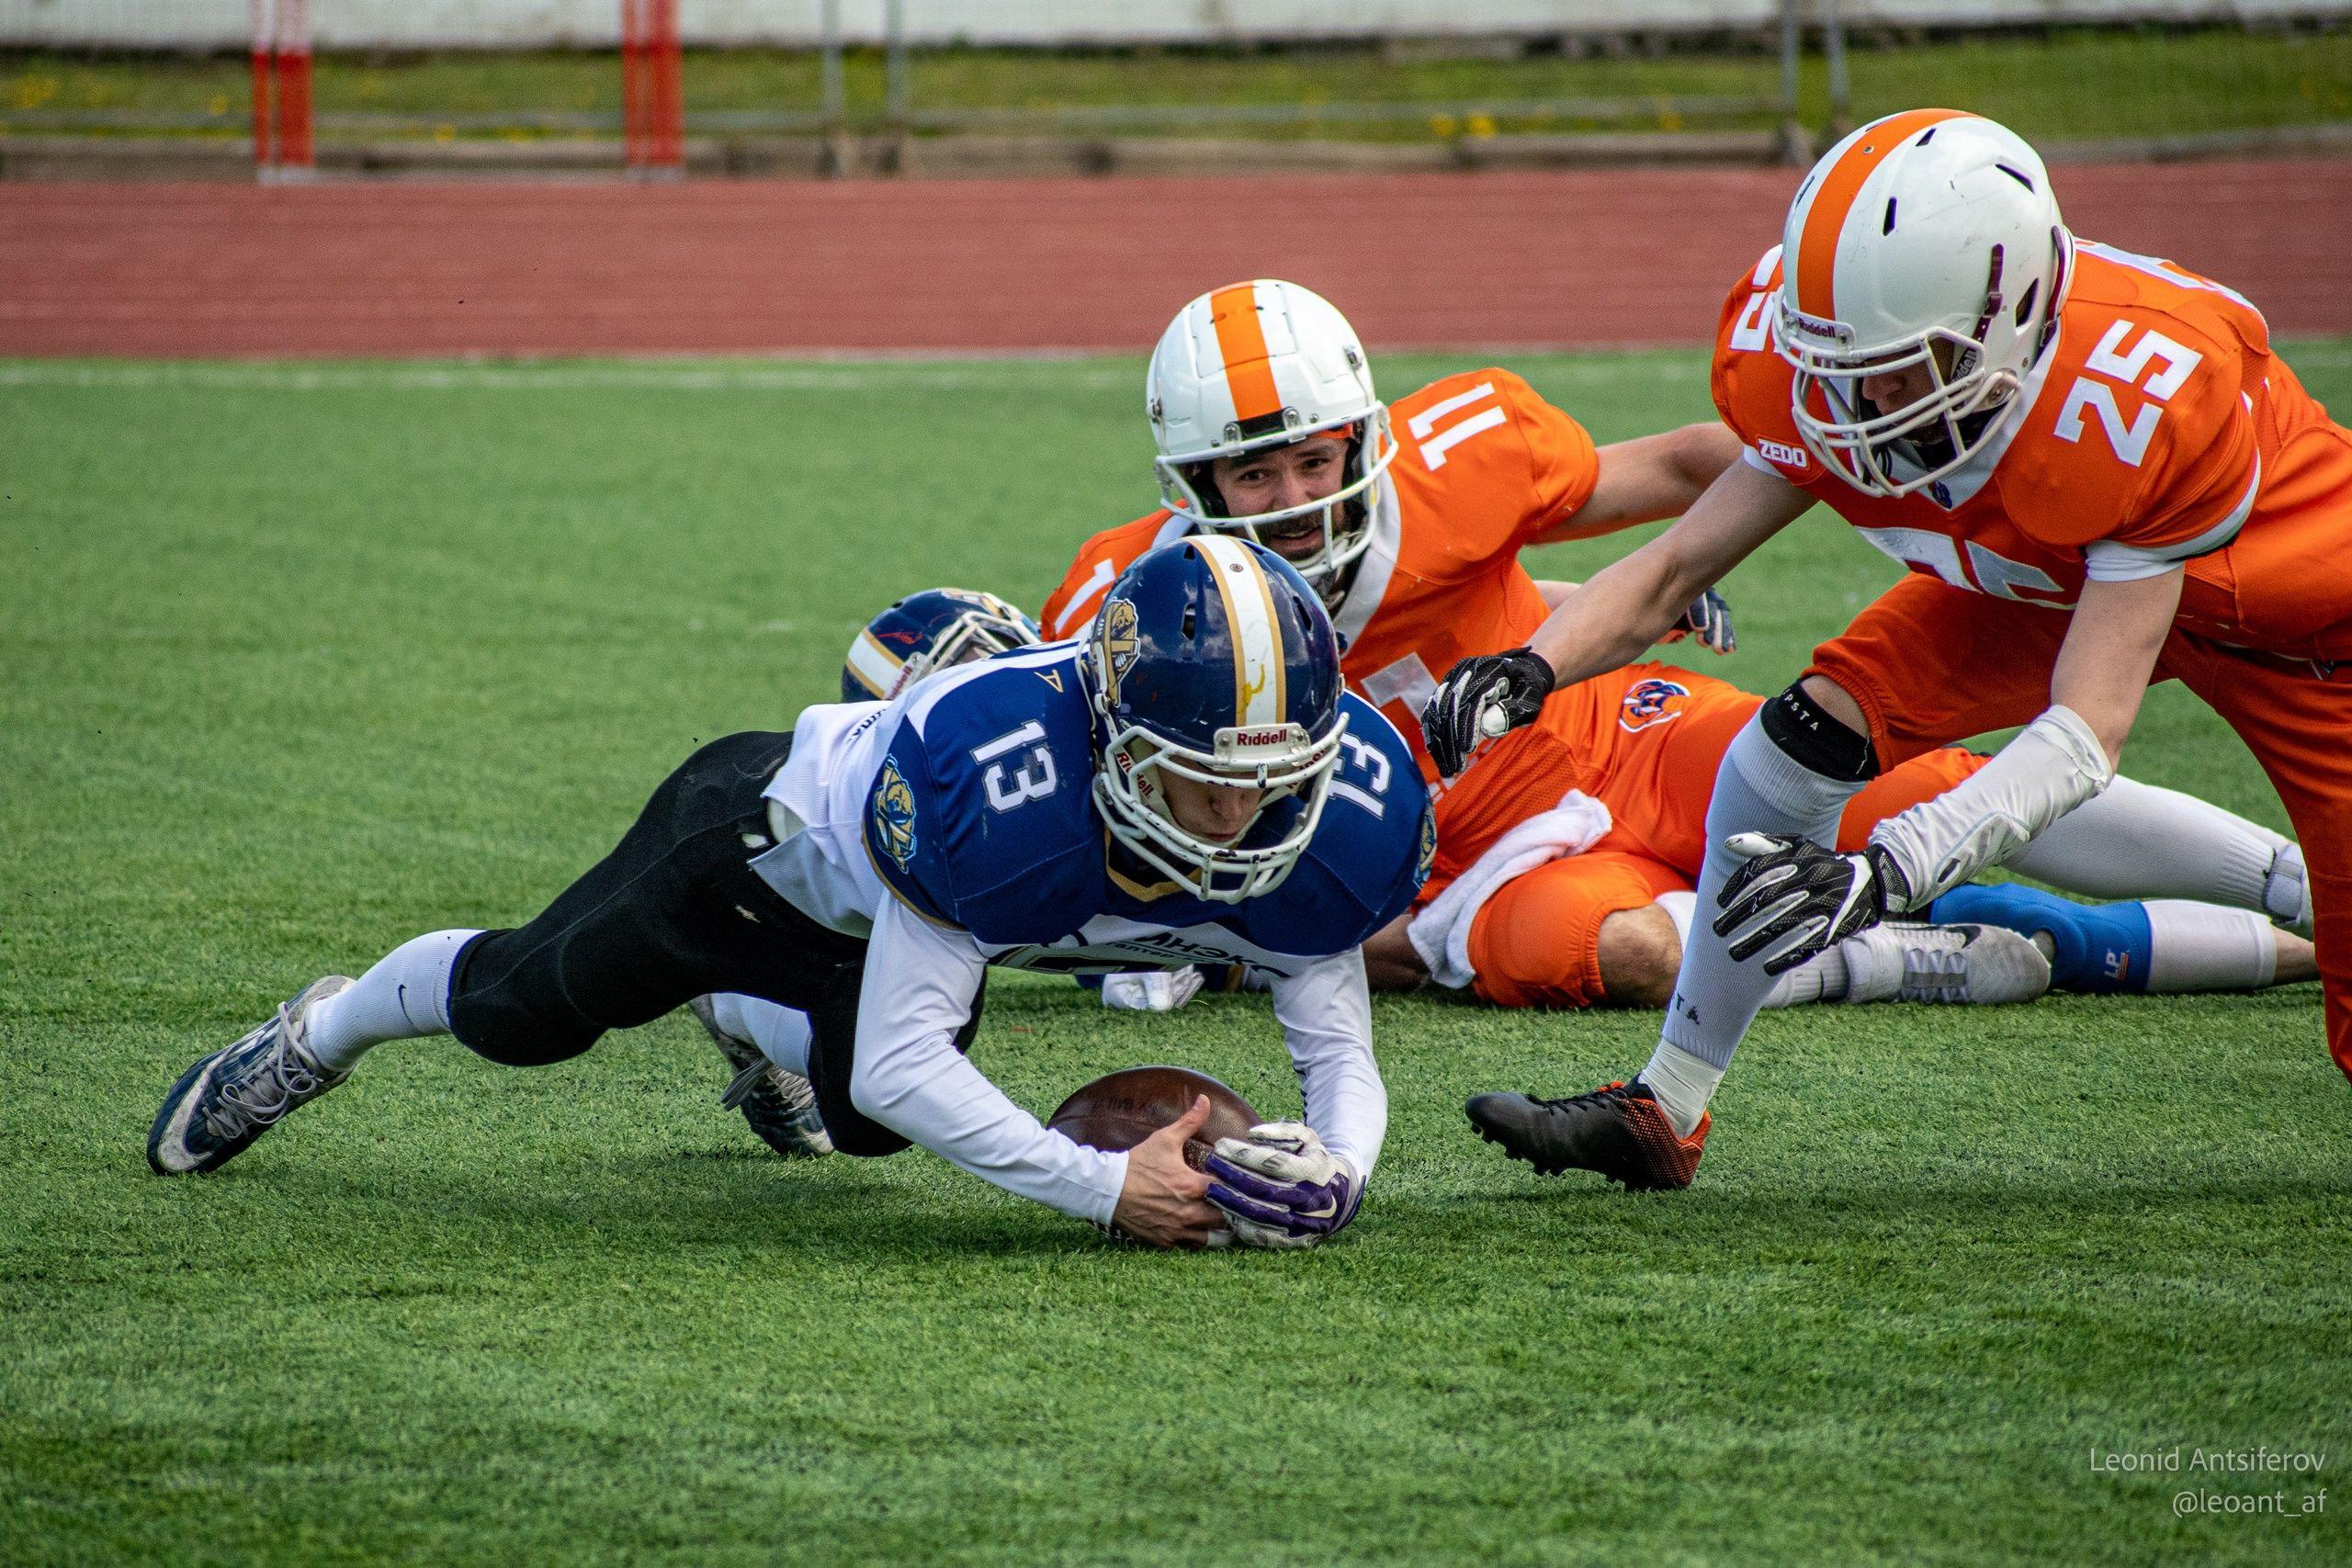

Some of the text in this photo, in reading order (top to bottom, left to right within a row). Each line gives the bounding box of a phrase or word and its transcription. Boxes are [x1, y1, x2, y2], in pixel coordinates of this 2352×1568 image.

[1798, 316, 1837, 339] Riddell
[1407, 381, 1507, 471] 11
[2053, 319, 2204, 468] 25
[1758, 438, 1807, 468] ZEDO
[969, 718, 1058, 814] 13
[1237, 728, 1287, 746] Riddell
[1328, 732, 1392, 820] 13
